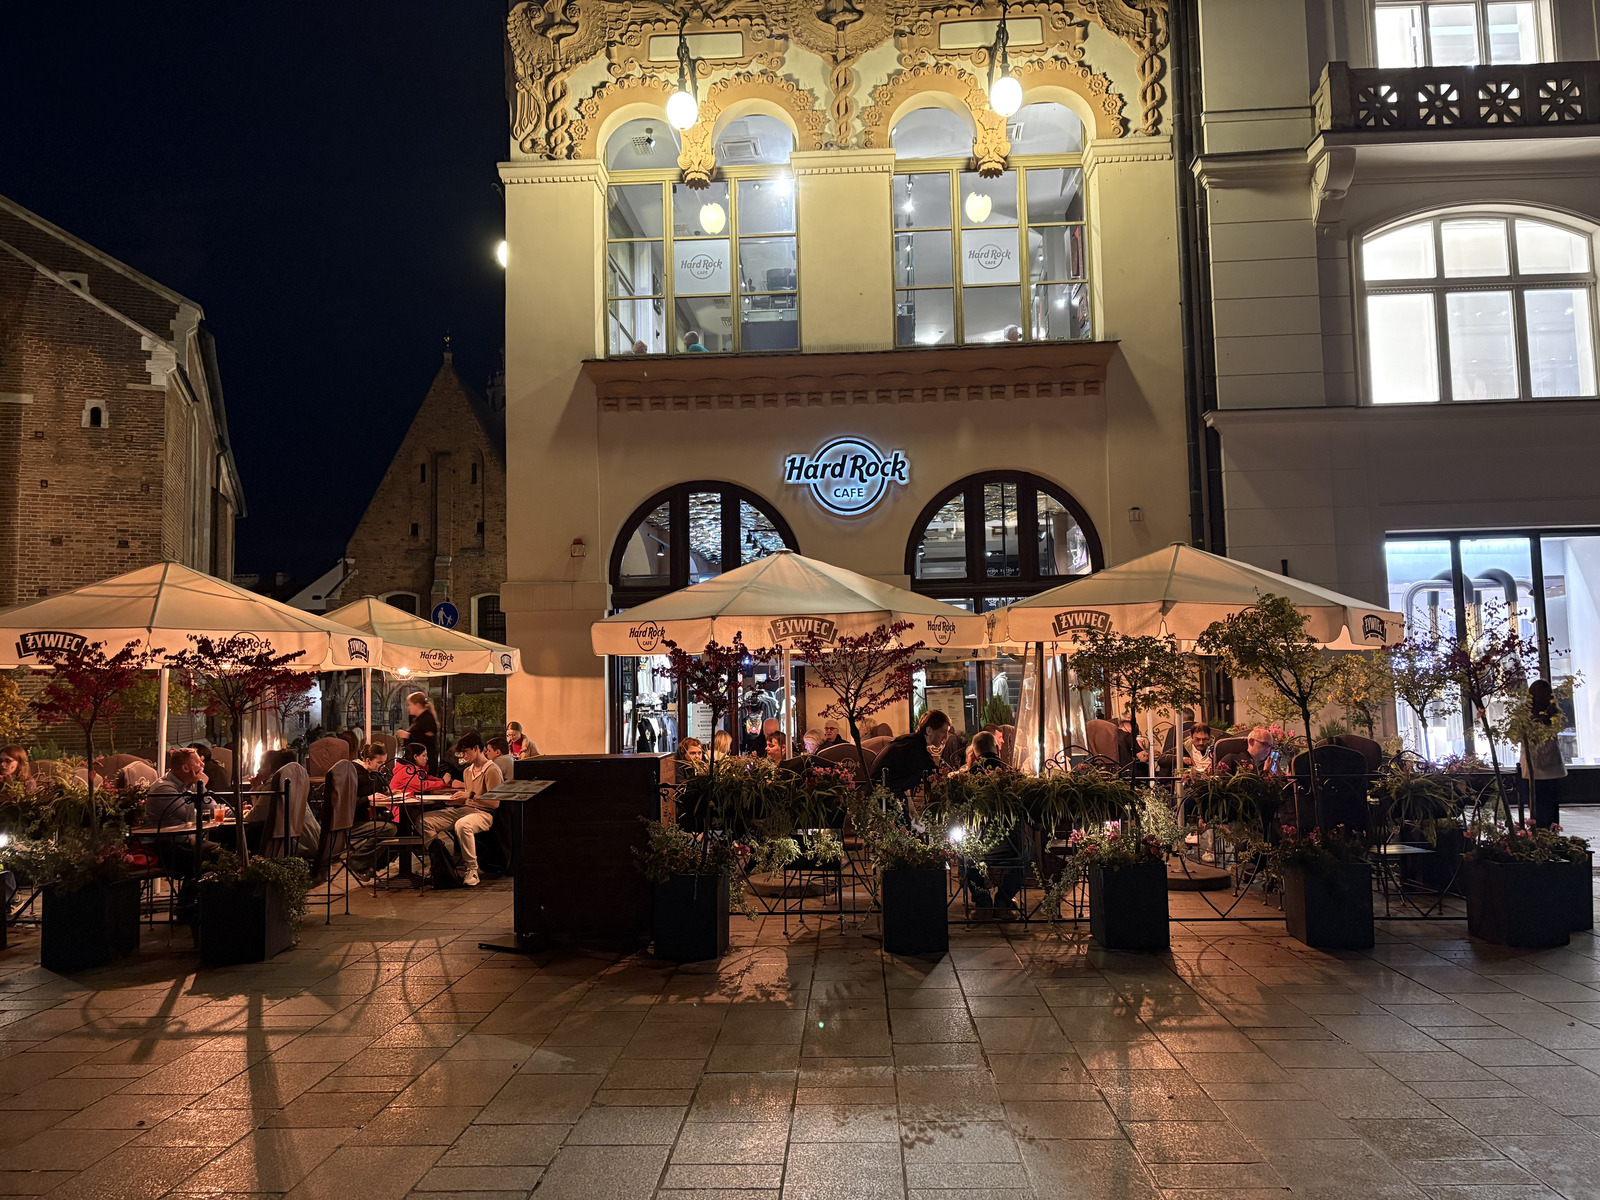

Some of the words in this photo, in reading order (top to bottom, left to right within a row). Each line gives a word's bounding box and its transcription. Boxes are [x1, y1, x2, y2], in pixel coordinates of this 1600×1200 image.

[968, 250, 990, 259] Hard
[991, 249, 1011, 260] Rock
[681, 260, 702, 269] Hard
[703, 259, 722, 270] Rock
[786, 454, 848, 480] Hard
[849, 453, 906, 483] Rock
[833, 488, 864, 498] CAFE
[776, 619, 829, 636] ŻYWIEC
[927, 620, 941, 631] Hard
[942, 621, 956, 634] Rock
[1060, 612, 1106, 629] ŻYWIEC
[629, 627, 648, 638] Hard
[648, 626, 666, 640] Rock
[25, 633, 82, 652] ŻYWIEC
[419, 651, 437, 660] Hard
[438, 652, 454, 663] Rock
